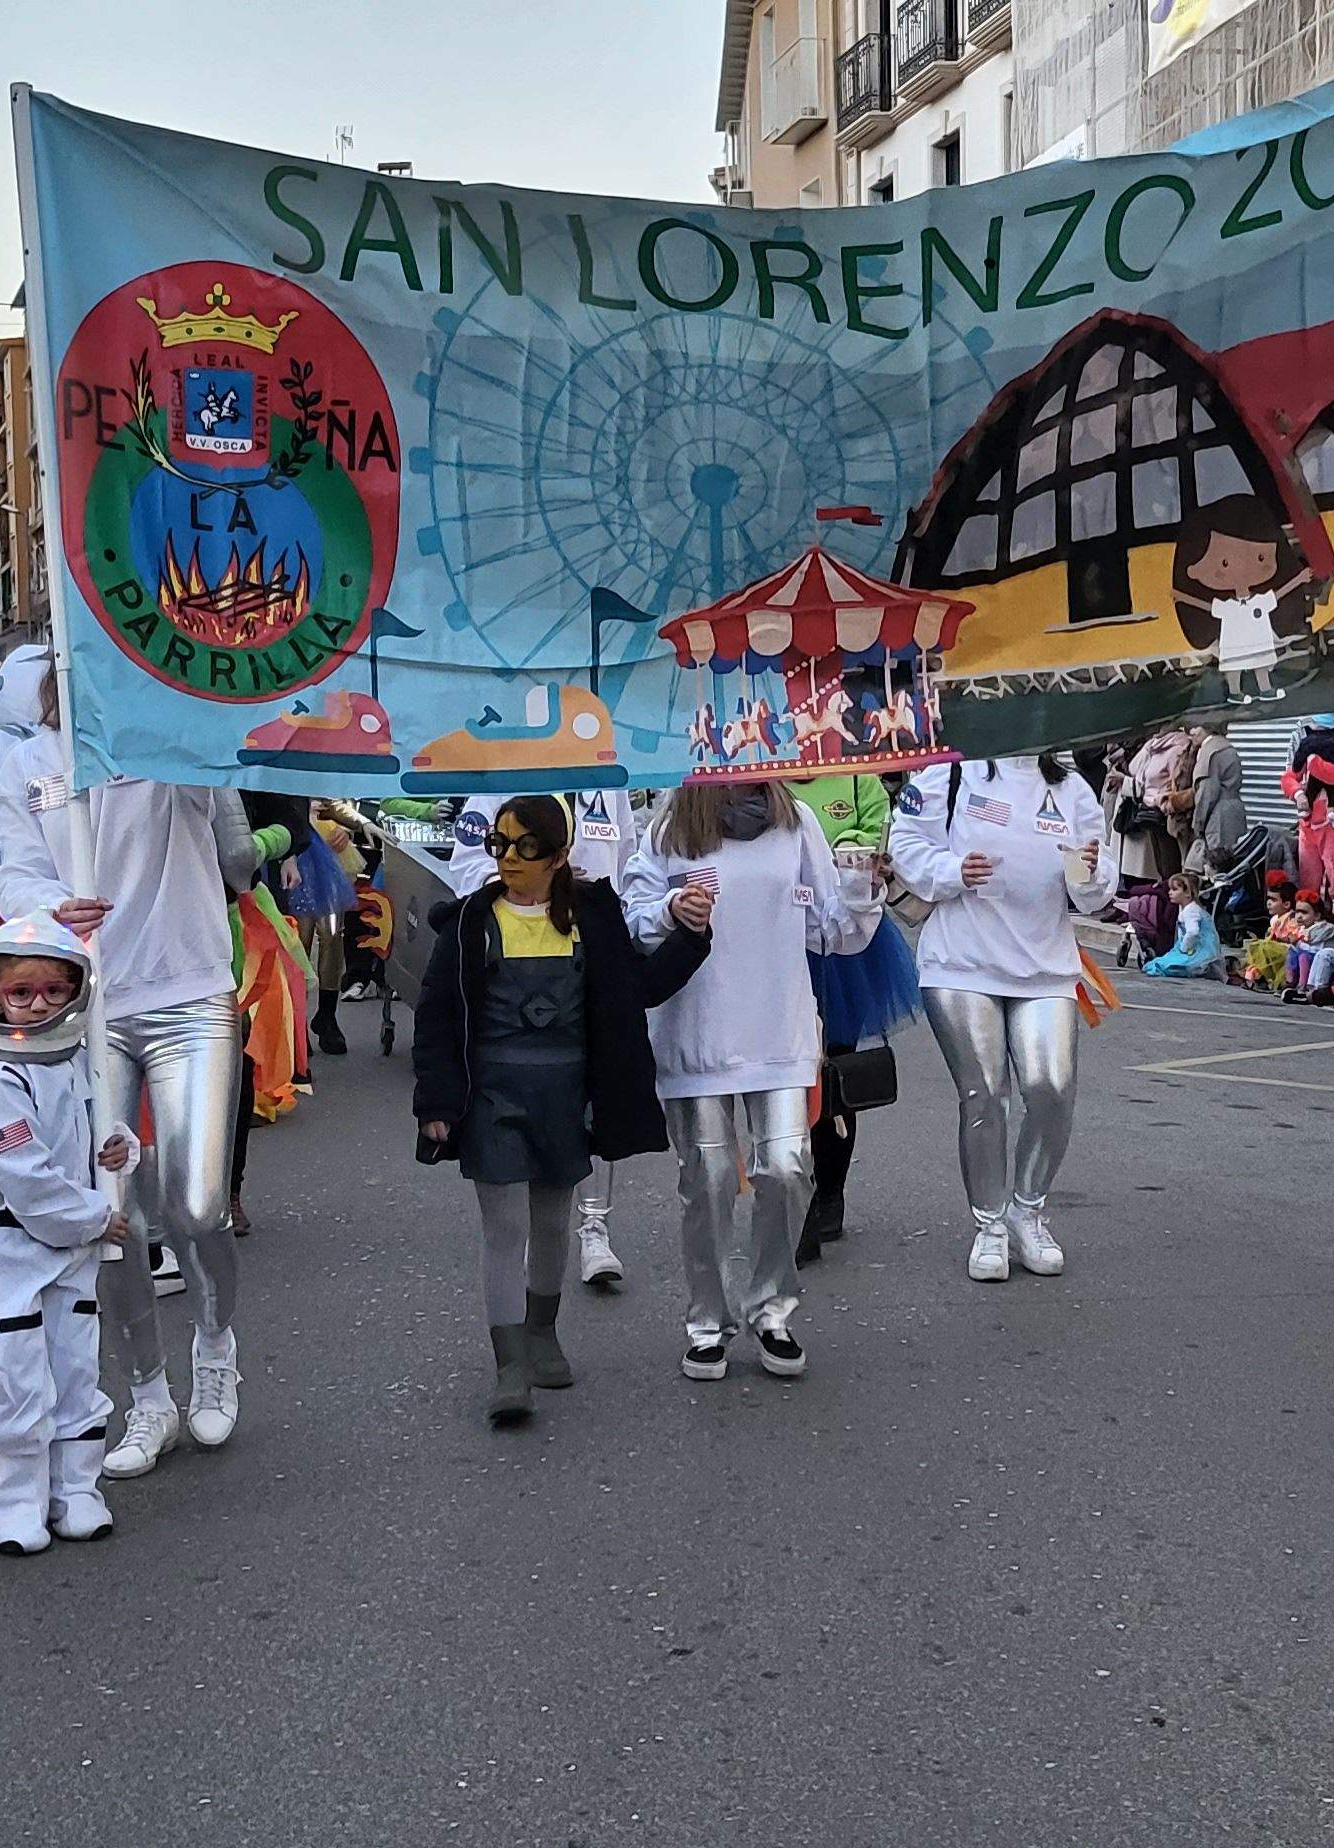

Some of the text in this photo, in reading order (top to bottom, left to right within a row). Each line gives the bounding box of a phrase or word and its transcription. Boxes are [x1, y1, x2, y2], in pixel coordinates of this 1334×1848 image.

[264, 165, 523, 296] SAN
[568, 174, 1196, 340] LORENZO
[194, 353, 245, 369] LEAL
[255, 375, 268, 451] INVICTA
[213, 440, 247, 451] OSCA
[190, 493, 258, 536] LA
[104, 578, 351, 691] PARRILLA
[584, 825, 617, 838] NASA
[1037, 820, 1070, 835] NASA
